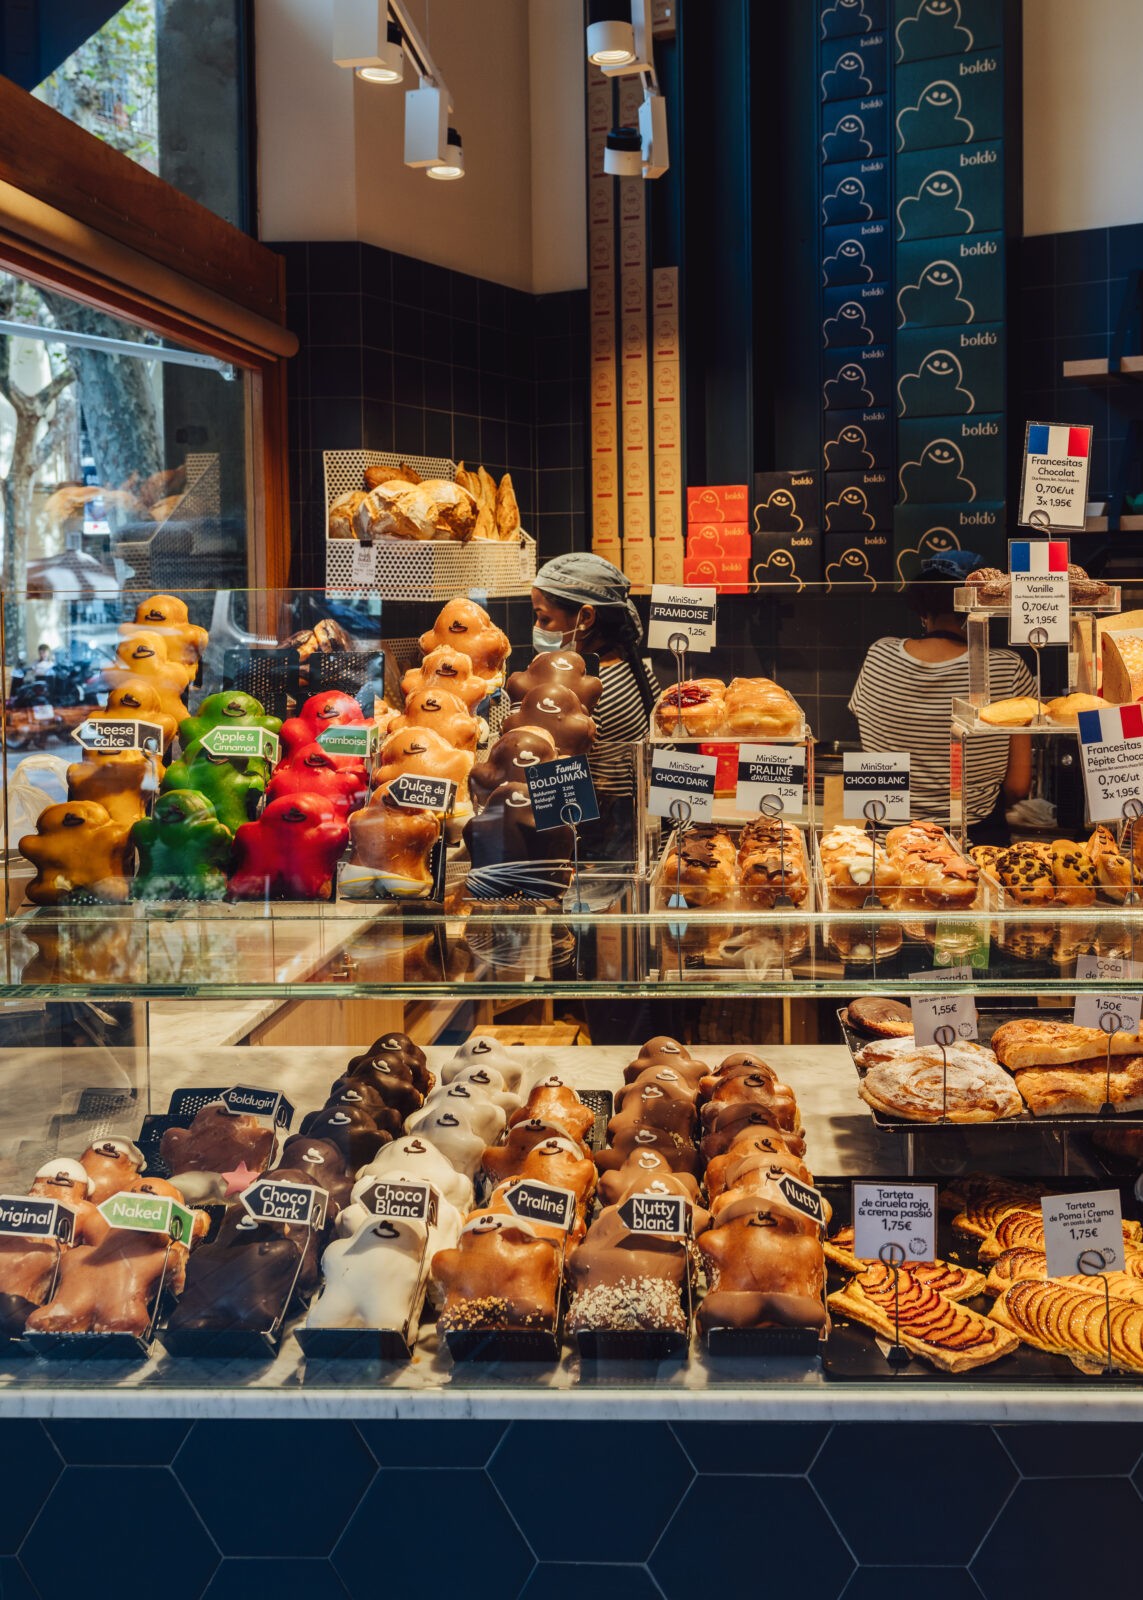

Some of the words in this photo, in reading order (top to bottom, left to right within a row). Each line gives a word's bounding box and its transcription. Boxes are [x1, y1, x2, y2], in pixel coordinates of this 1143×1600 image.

[959, 58, 996, 76] boldú
[960, 150, 997, 167] boldú
[960, 241, 997, 257] boldú
[960, 332, 997, 347] boldú
[962, 422, 999, 437] boldú
[1031, 456, 1083, 467] Francesitas
[1038, 467, 1075, 477] Chocolat
[1036, 483, 1074, 495] 0,70€/ut
[1036, 496, 1047, 506] 3x
[1049, 499, 1072, 508] 1,95€
[960, 512, 996, 525] boldú
[1027, 585, 1054, 593] Vanille
[654, 607, 708, 620] FRAMBOISE
[1022, 602, 1059, 612] 0,70€/ut
[1023, 615, 1034, 624] 3x
[1036, 616, 1057, 625] 1,95€
[688, 627, 706, 636] 1,25€
[86, 722, 134, 735] Cheese
[94, 734, 125, 747] cake
[213, 731, 245, 743] Apple
[246, 733, 255, 742] &
[320, 735, 366, 746] Framboise
[213, 743, 256, 752] Cinnamon
[1087, 741, 1141, 755] Francesitas
[555, 761, 581, 774] Family
[1087, 756, 1115, 767] Pépite
[750, 764, 793, 776] PRALINÉ
[656, 773, 685, 783] CHOCO
[686, 777, 709, 787] DARK
[1098, 773, 1140, 786] 0,70€/ut
[400, 778, 432, 792] Dulce
[434, 786, 444, 795] de
[778, 787, 797, 797] 1,25€
[1102, 789, 1115, 799] 3x
[1116, 787, 1140, 798] 1,95€
[403, 791, 437, 805] Leche
[689, 796, 708, 806] 1,25€
[884, 794, 904, 804] 1,25€
[1097, 961, 1121, 972] Coca
[932, 1004, 958, 1015] 1,55€
[1096, 999, 1122, 1012] 1,50€
[229, 1092, 276, 1110] Boldugirl
[260, 1186, 307, 1205] Choco
[374, 1185, 422, 1203] Choco
[785, 1180, 819, 1214] Nutty
[877, 1188, 913, 1200] Tarteta
[375, 1201, 419, 1217] Blanc
[516, 1190, 565, 1215] Praliné
[632, 1199, 676, 1217] Nutty
[862, 1199, 873, 1207] de
[875, 1200, 907, 1208] ciruela
[910, 1200, 929, 1211] roja
[1065, 1202, 1095, 1210] Tarteta
[0, 1206, 52, 1227] riginal
[112, 1202, 162, 1221] Naked
[262, 1201, 300, 1219] Dark
[858, 1208, 865, 1216] &
[867, 1208, 898, 1217] crema
[900, 1208, 932, 1219] passió
[1058, 1212, 1082, 1221] Poma
[1087, 1209, 1114, 1218] Crema
[632, 1213, 674, 1231] blanc
[881, 1218, 912, 1231] 1,75€
[1069, 1228, 1098, 1240] 1,75€
